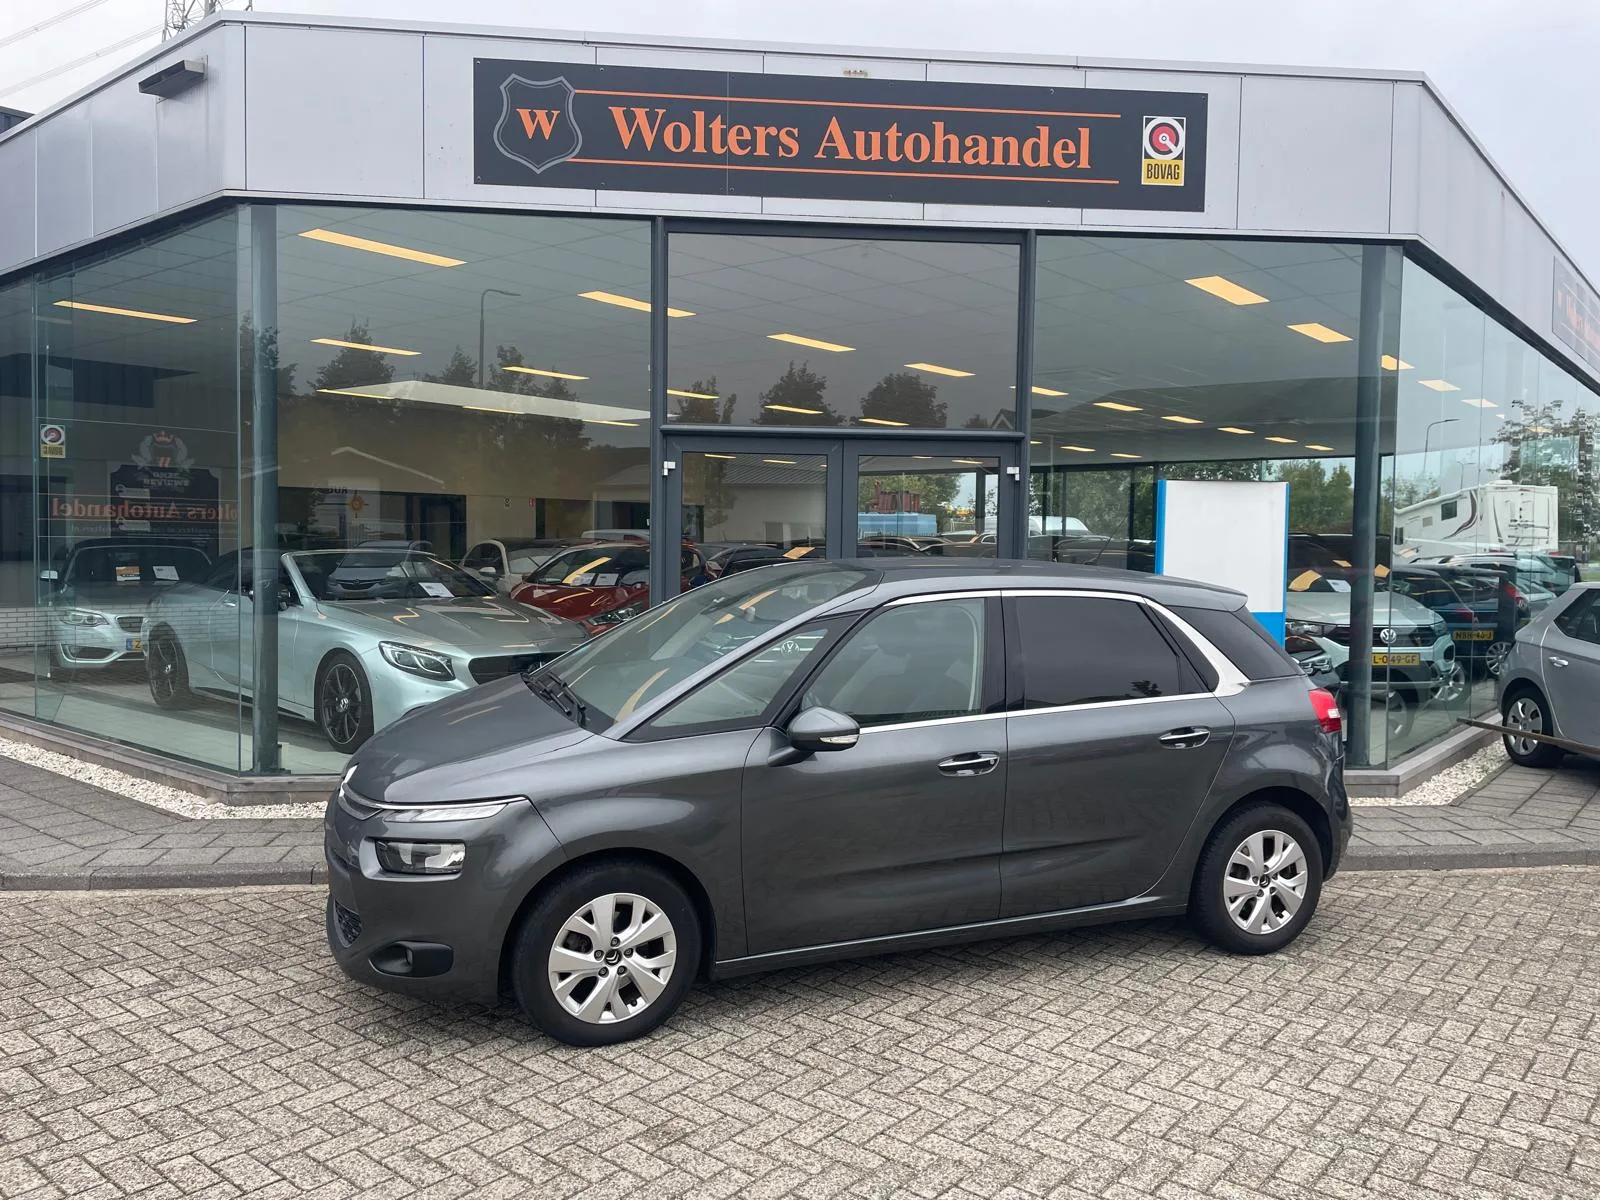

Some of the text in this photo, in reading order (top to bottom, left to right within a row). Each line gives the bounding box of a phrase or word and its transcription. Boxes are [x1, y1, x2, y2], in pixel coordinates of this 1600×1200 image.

[516, 108, 560, 141] W
[608, 106, 1092, 170] Wolters Autohandel
[1146, 163, 1180, 180] BOVAG
